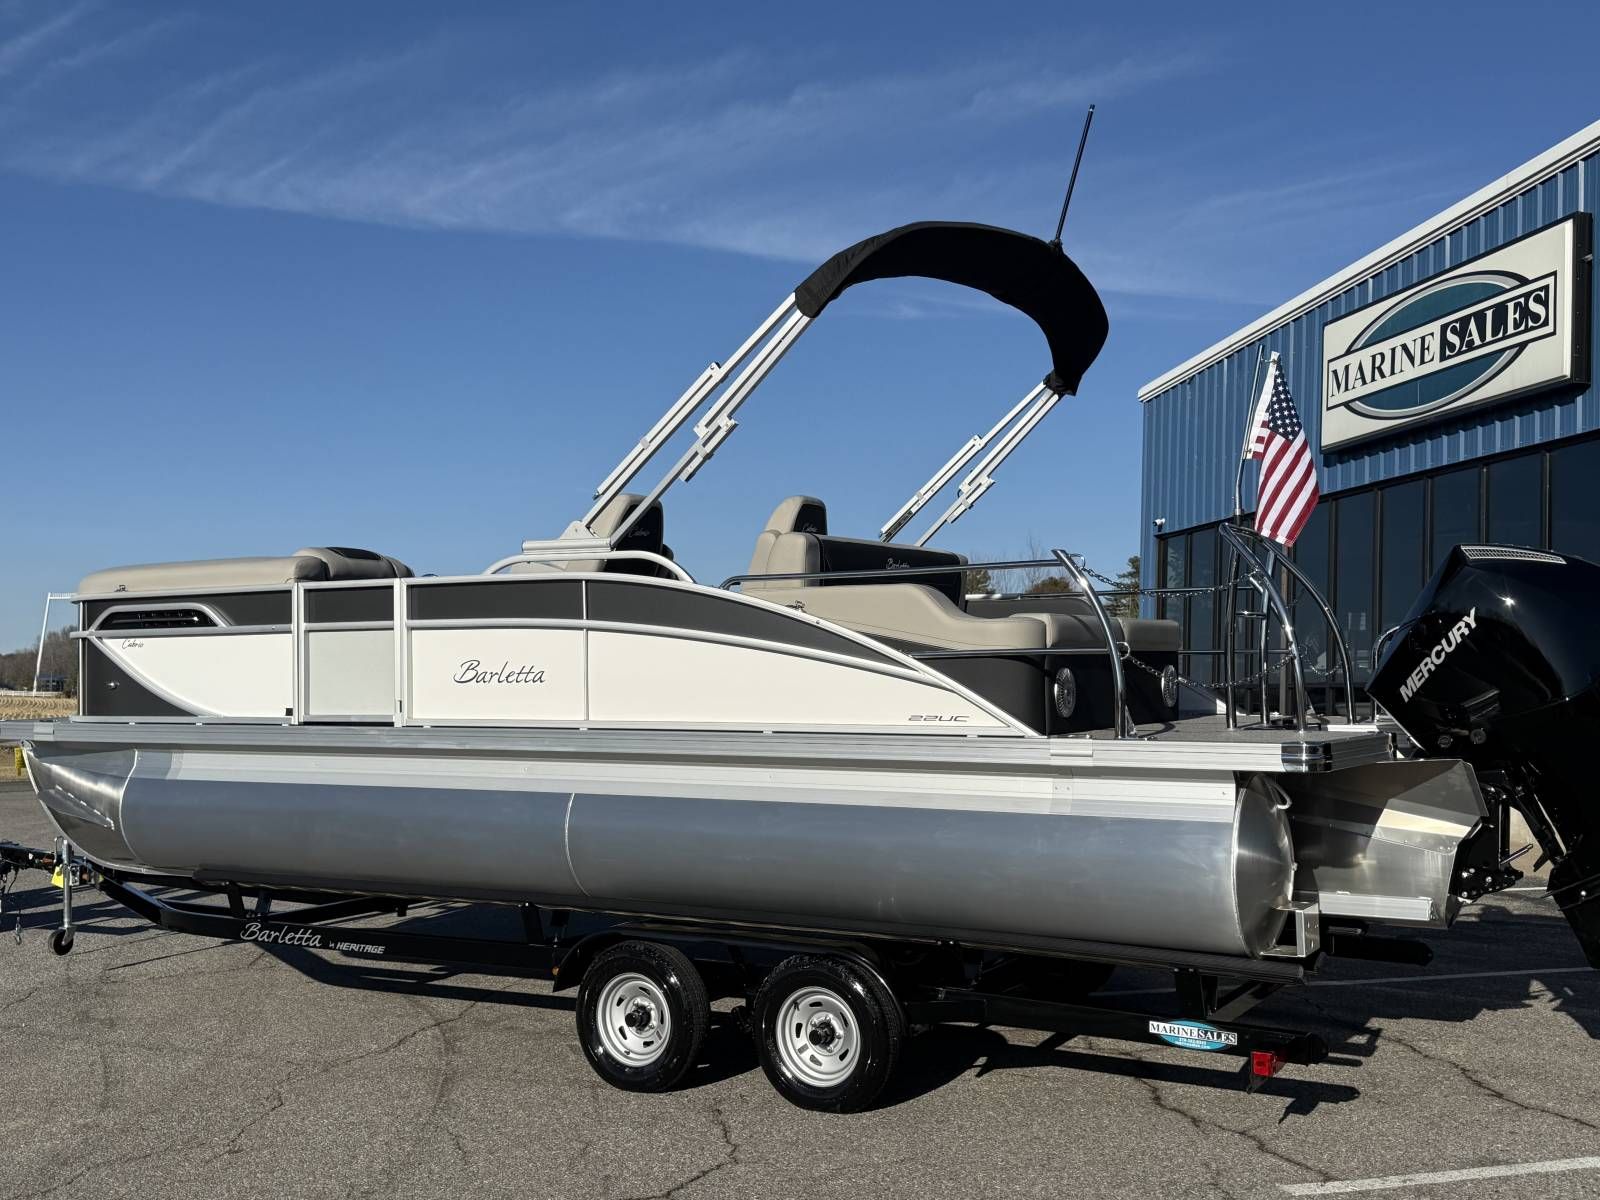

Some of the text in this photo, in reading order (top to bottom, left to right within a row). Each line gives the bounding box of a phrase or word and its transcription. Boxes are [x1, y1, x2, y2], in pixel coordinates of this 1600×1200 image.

[1329, 290, 1547, 398] MARINE SALES
[121, 639, 145, 650] Cabrio
[1399, 606, 1477, 703] MERCURY
[453, 659, 545, 684] Barletta
[240, 922, 322, 947] Barletta
[336, 942, 385, 954] HERITAGE
[1150, 1023, 1196, 1037] MARINE
[1198, 1029, 1236, 1044] SALES
